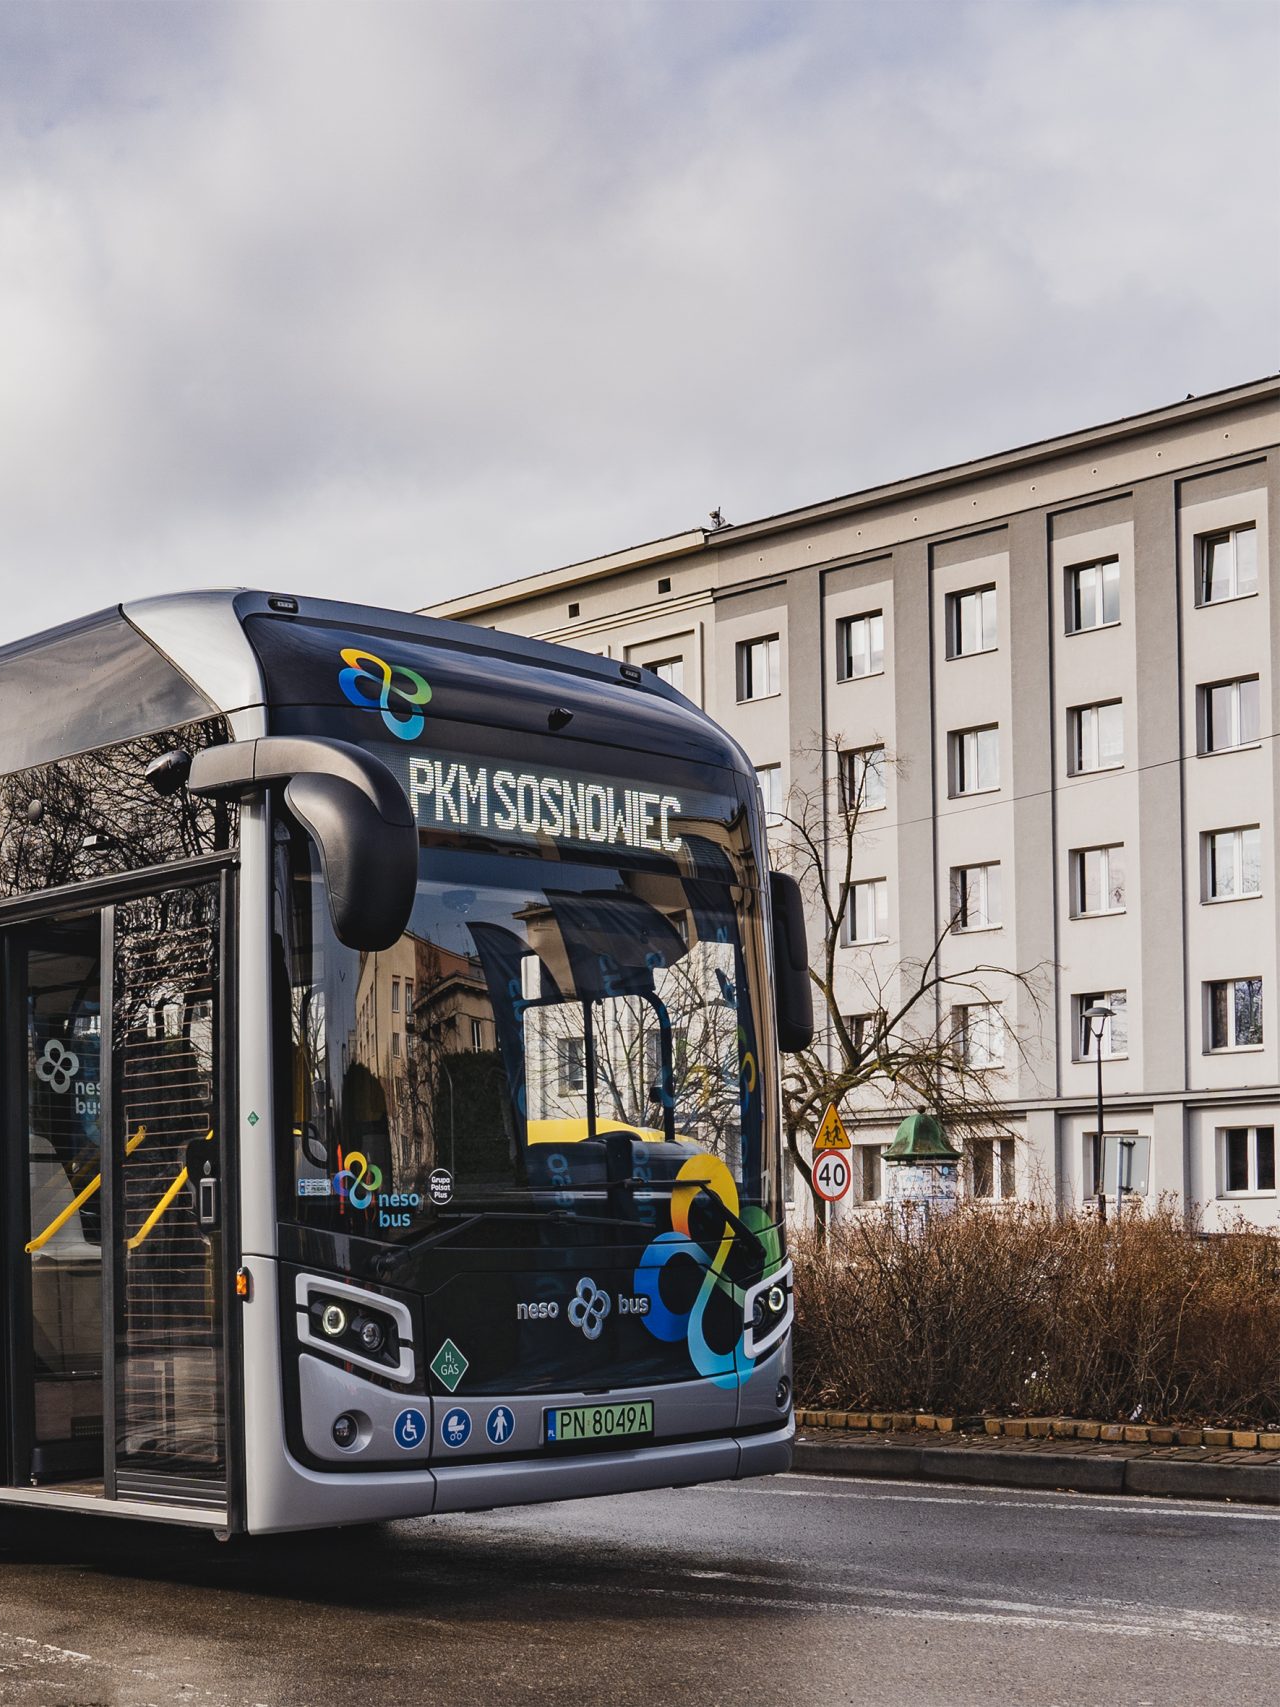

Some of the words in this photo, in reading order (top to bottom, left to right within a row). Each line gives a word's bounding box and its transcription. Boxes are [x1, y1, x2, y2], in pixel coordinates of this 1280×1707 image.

[409, 757, 489, 825] PKM
[494, 771, 681, 852] SOSNOWIEC
[75, 1081, 100, 1095] nes
[431, 1176, 451, 1184] Grupa
[818, 1163, 845, 1187] 40
[379, 1192, 419, 1207] neso
[379, 1212, 411, 1227] bus
[517, 1301, 559, 1320] neso
[618, 1294, 649, 1314] bus
[440, 1364, 460, 1375] GAS
[560, 1411, 586, 1438] PN
[593, 1406, 648, 1435] 8049A
